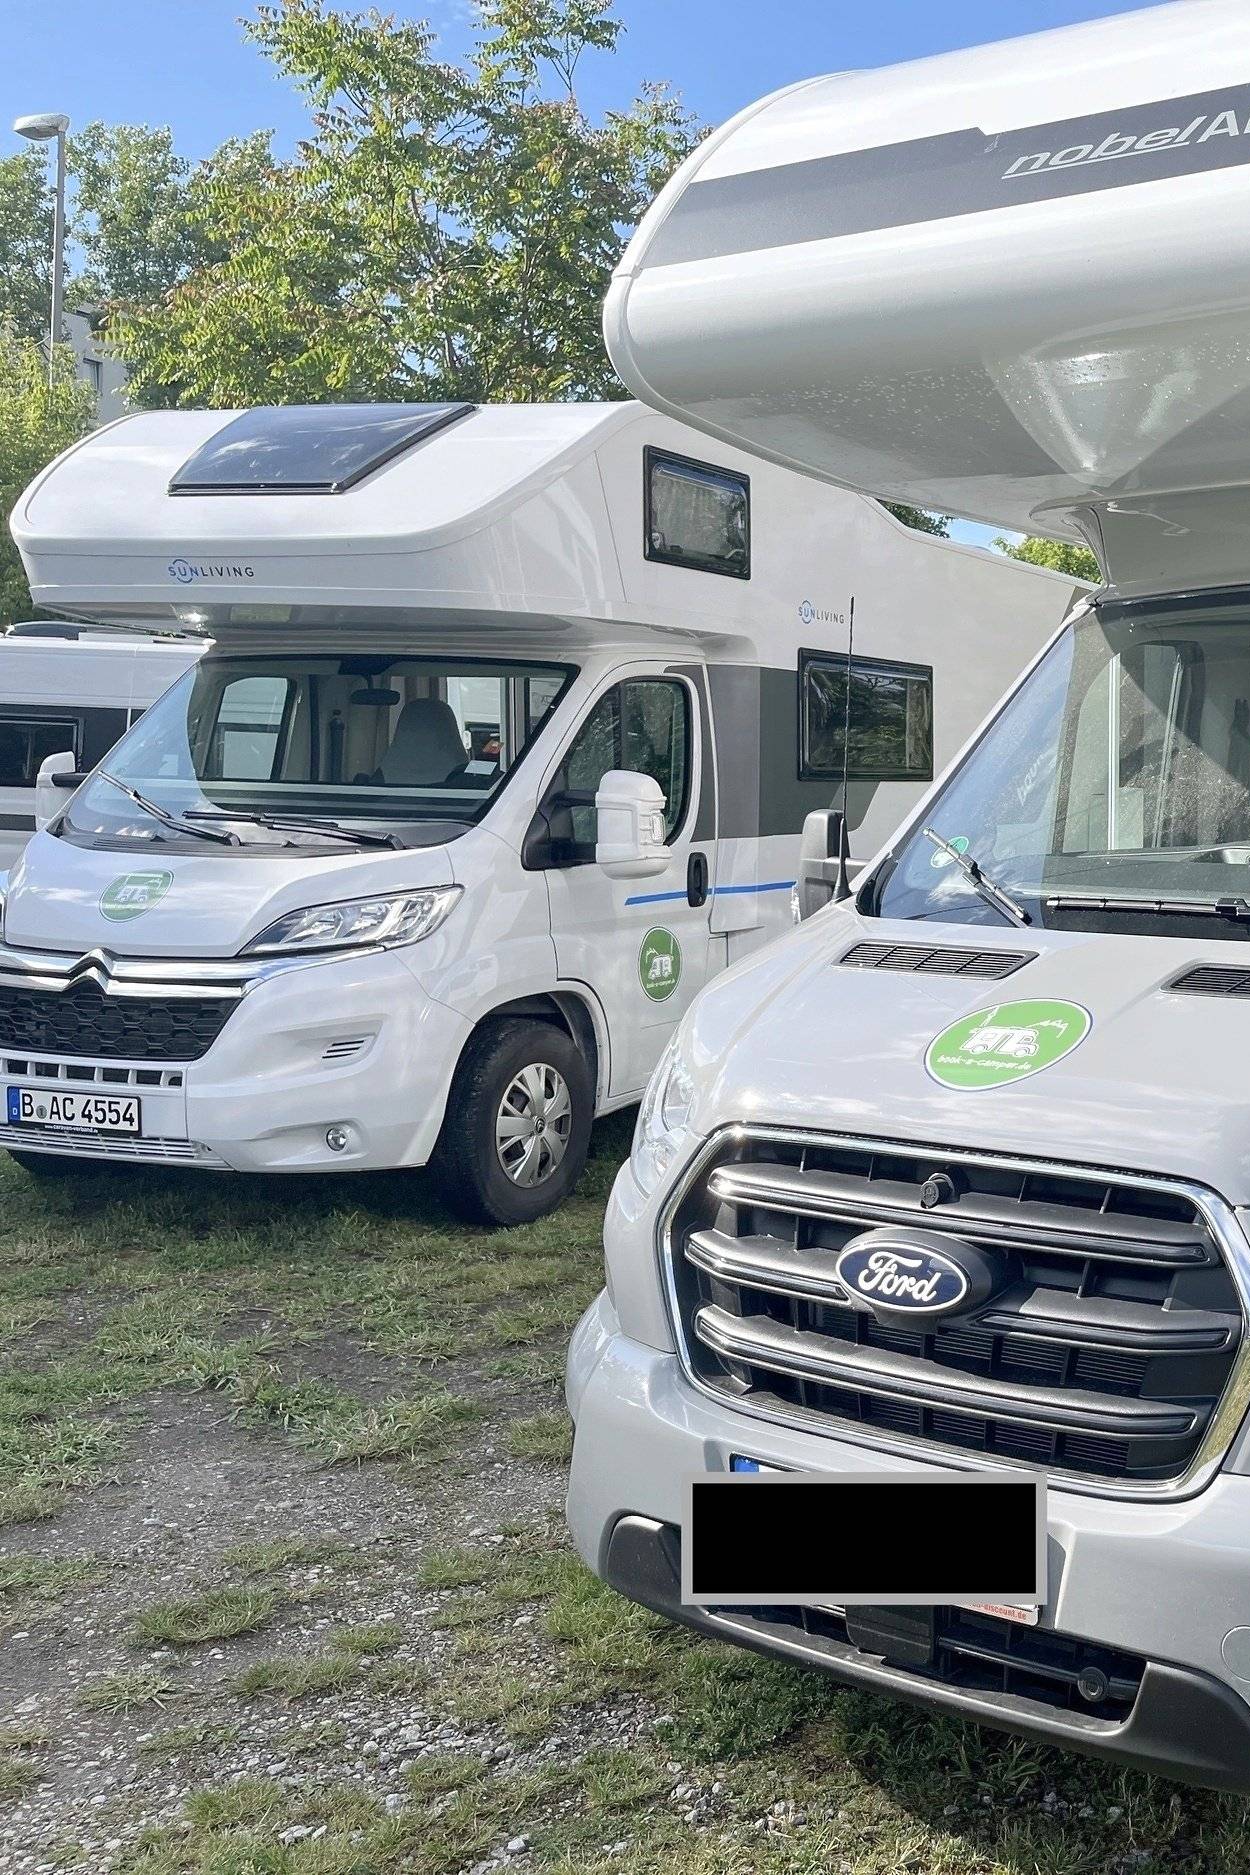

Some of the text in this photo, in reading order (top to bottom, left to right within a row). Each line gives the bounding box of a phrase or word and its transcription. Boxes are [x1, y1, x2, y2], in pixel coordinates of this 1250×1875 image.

[168, 561, 254, 580] SUNLIVING
[798, 602, 845, 624] SUNLIVING
[21, 1093, 136, 1127] B AC 4554
[858, 1251, 942, 1301] Ford
